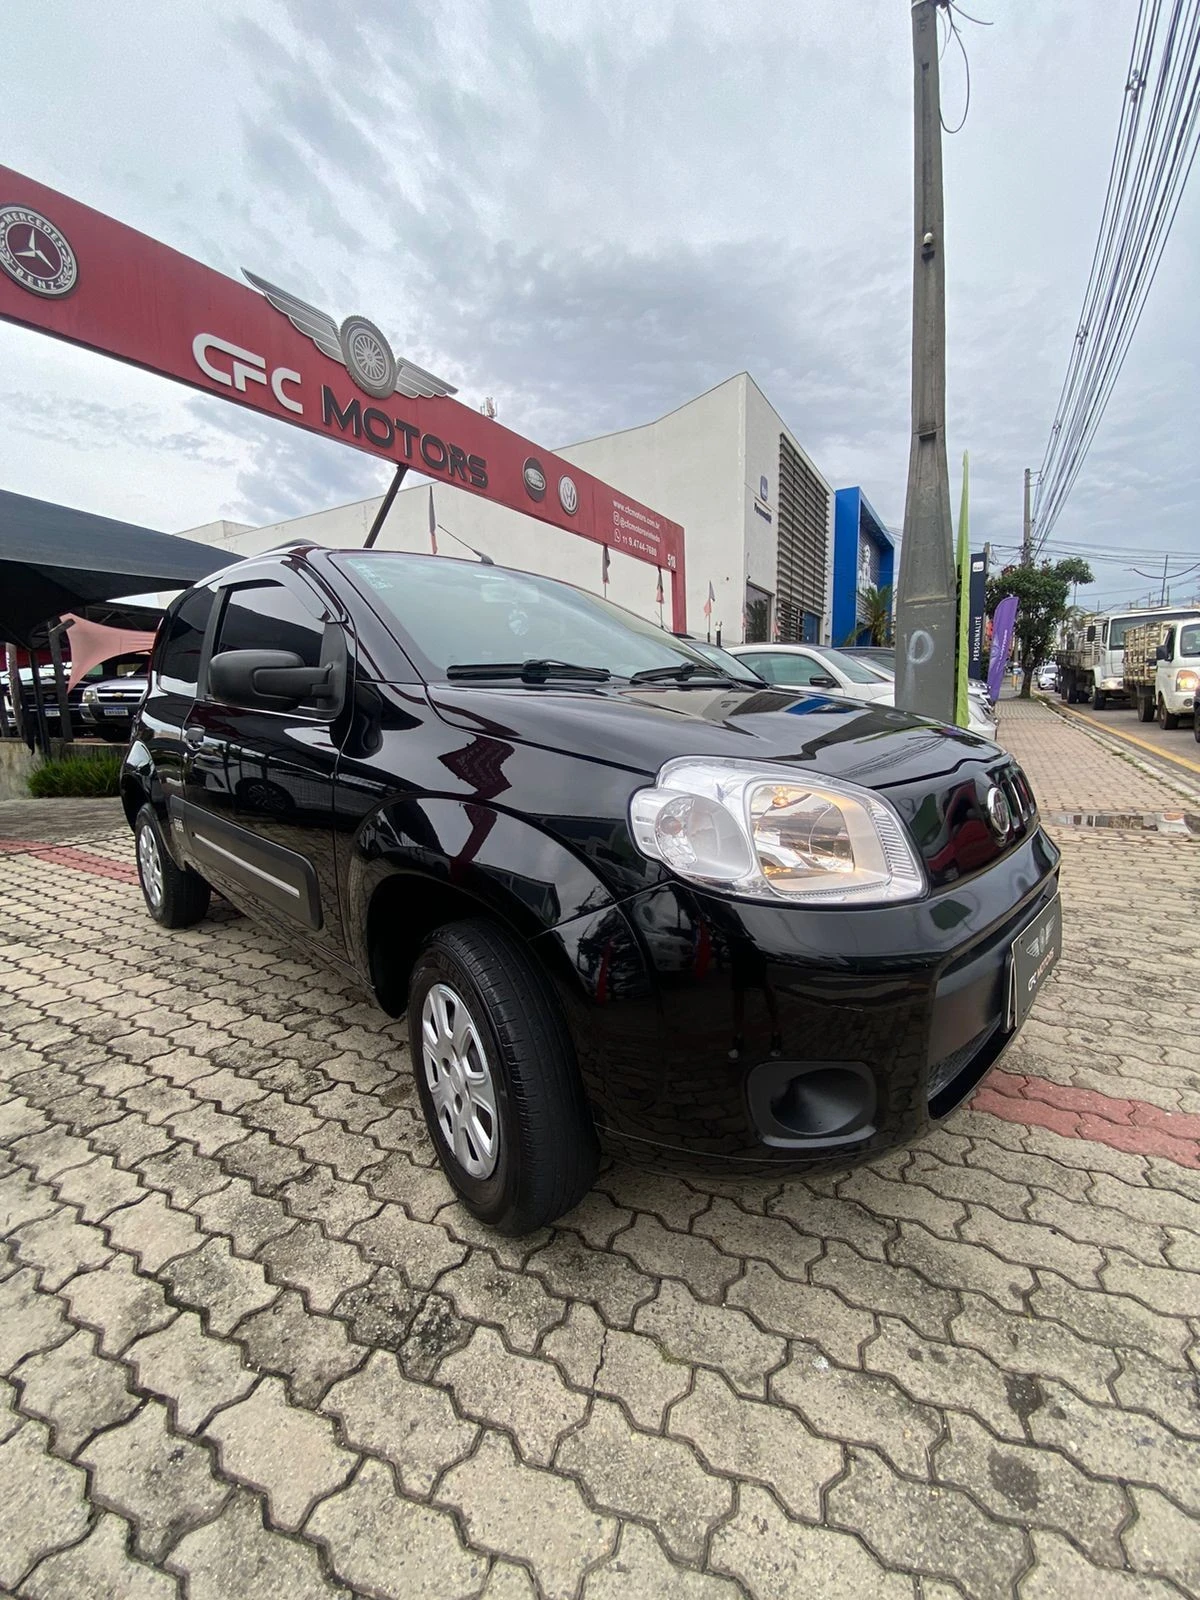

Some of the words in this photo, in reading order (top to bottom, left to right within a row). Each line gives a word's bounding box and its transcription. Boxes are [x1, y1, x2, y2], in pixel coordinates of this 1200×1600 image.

[3, 212, 65, 248] MERCEDES
[16, 268, 57, 290] BENZ
[192, 333, 304, 415] CFC
[321, 384, 488, 488] MOTORS
